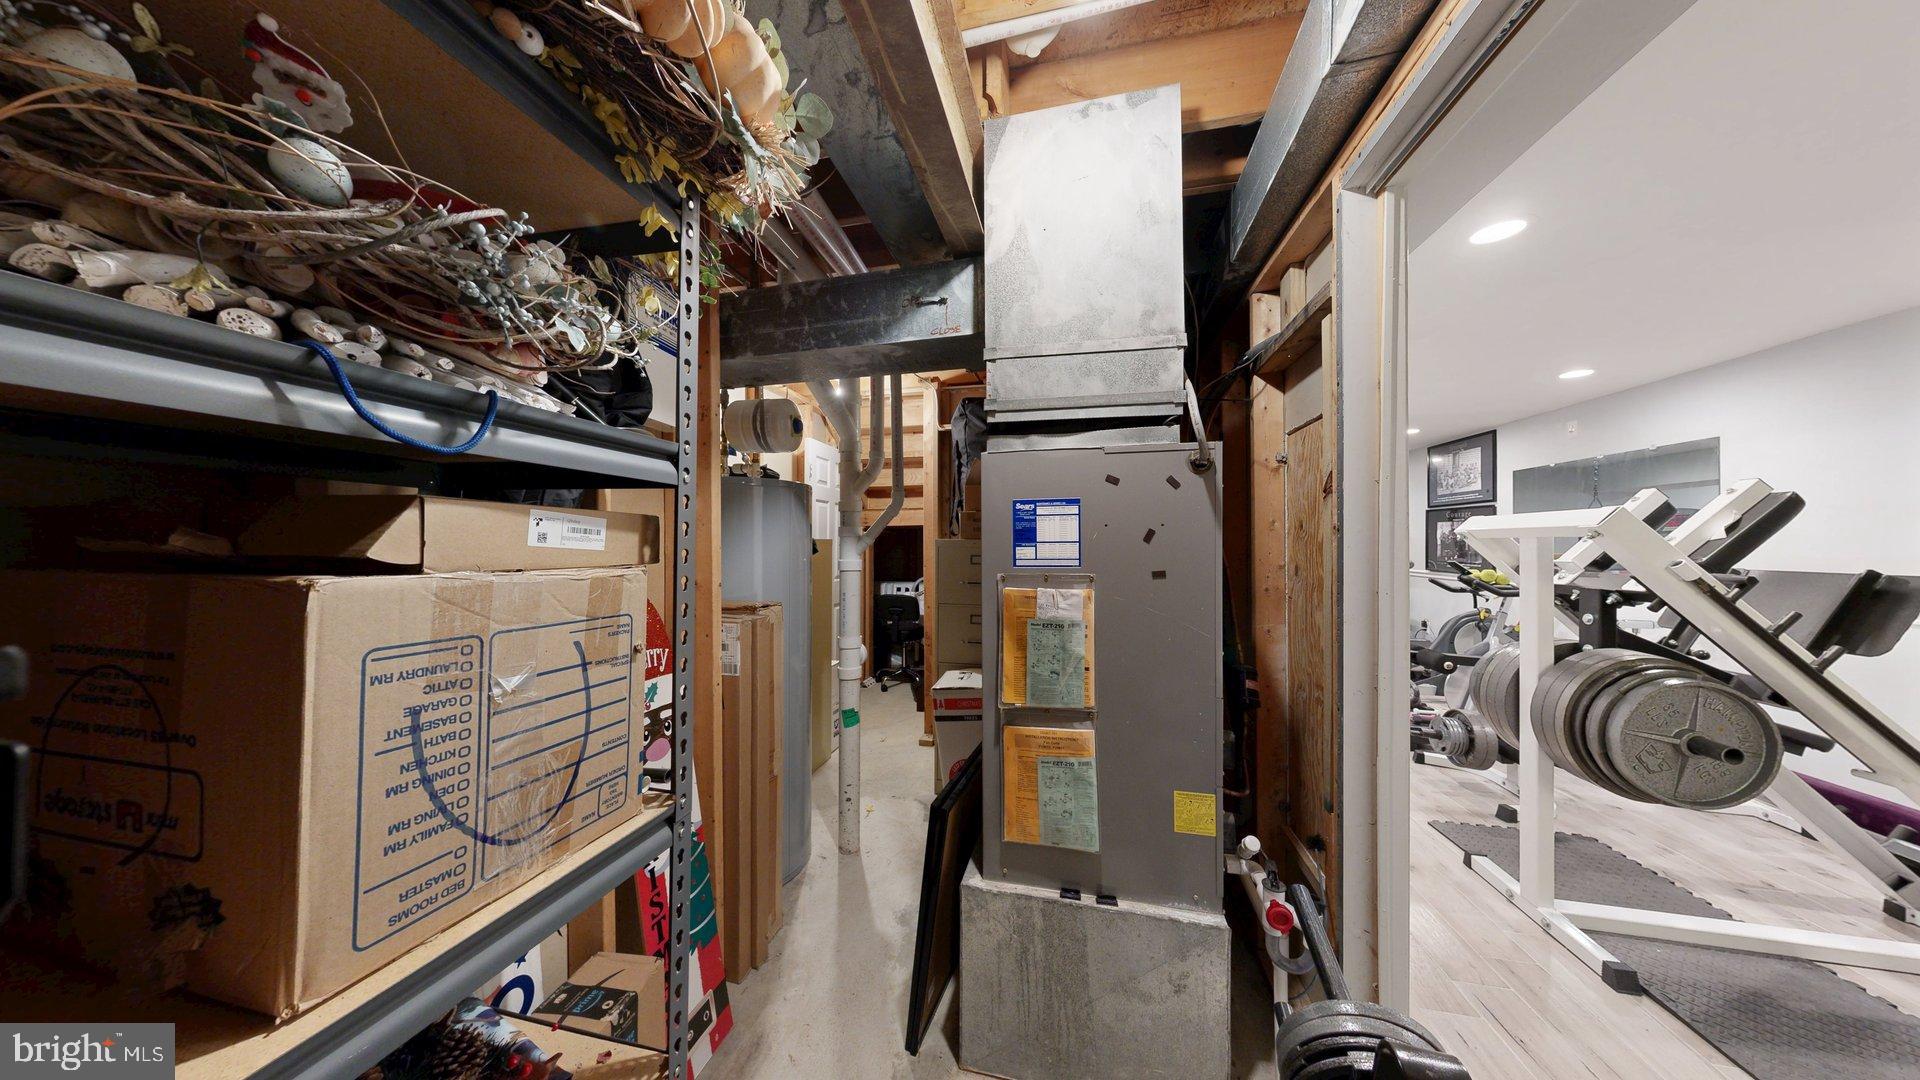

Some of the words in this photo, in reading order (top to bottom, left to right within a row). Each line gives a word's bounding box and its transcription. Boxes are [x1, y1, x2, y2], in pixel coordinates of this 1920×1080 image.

[930, 324, 961, 336] CLOSE
[1015, 502, 1035, 511] Sears
[1445, 510, 1473, 519] Courage
[370, 670, 393, 686] RM
[397, 662, 458, 681] LAUNDRY
[422, 679, 458, 694] ATTIC
[403, 698, 457, 717] GARAGE
[384, 715, 457, 741] BASEMENT
[424, 731, 457, 746] BATH
[601, 734, 626, 747] CONTENTS
[400, 749, 456, 774] KITCHEN
[413, 766, 456, 788] DINING
[585, 772, 606, 787] NUMBER
[606, 765, 626, 779] ORDER
[385, 782, 409, 797] RM
[429, 784, 455, 801] DEN
[414, 801, 455, 824] LIVING
[388, 818, 411, 834] RM
[410, 820, 454, 843] FAMILY
[383, 840, 406, 856] RM
[399, 869, 452, 902] MASTER
[441, 879, 465, 897] BED
[388, 893, 438, 927] ROOMS
[573, 989, 604, 1014] prime
